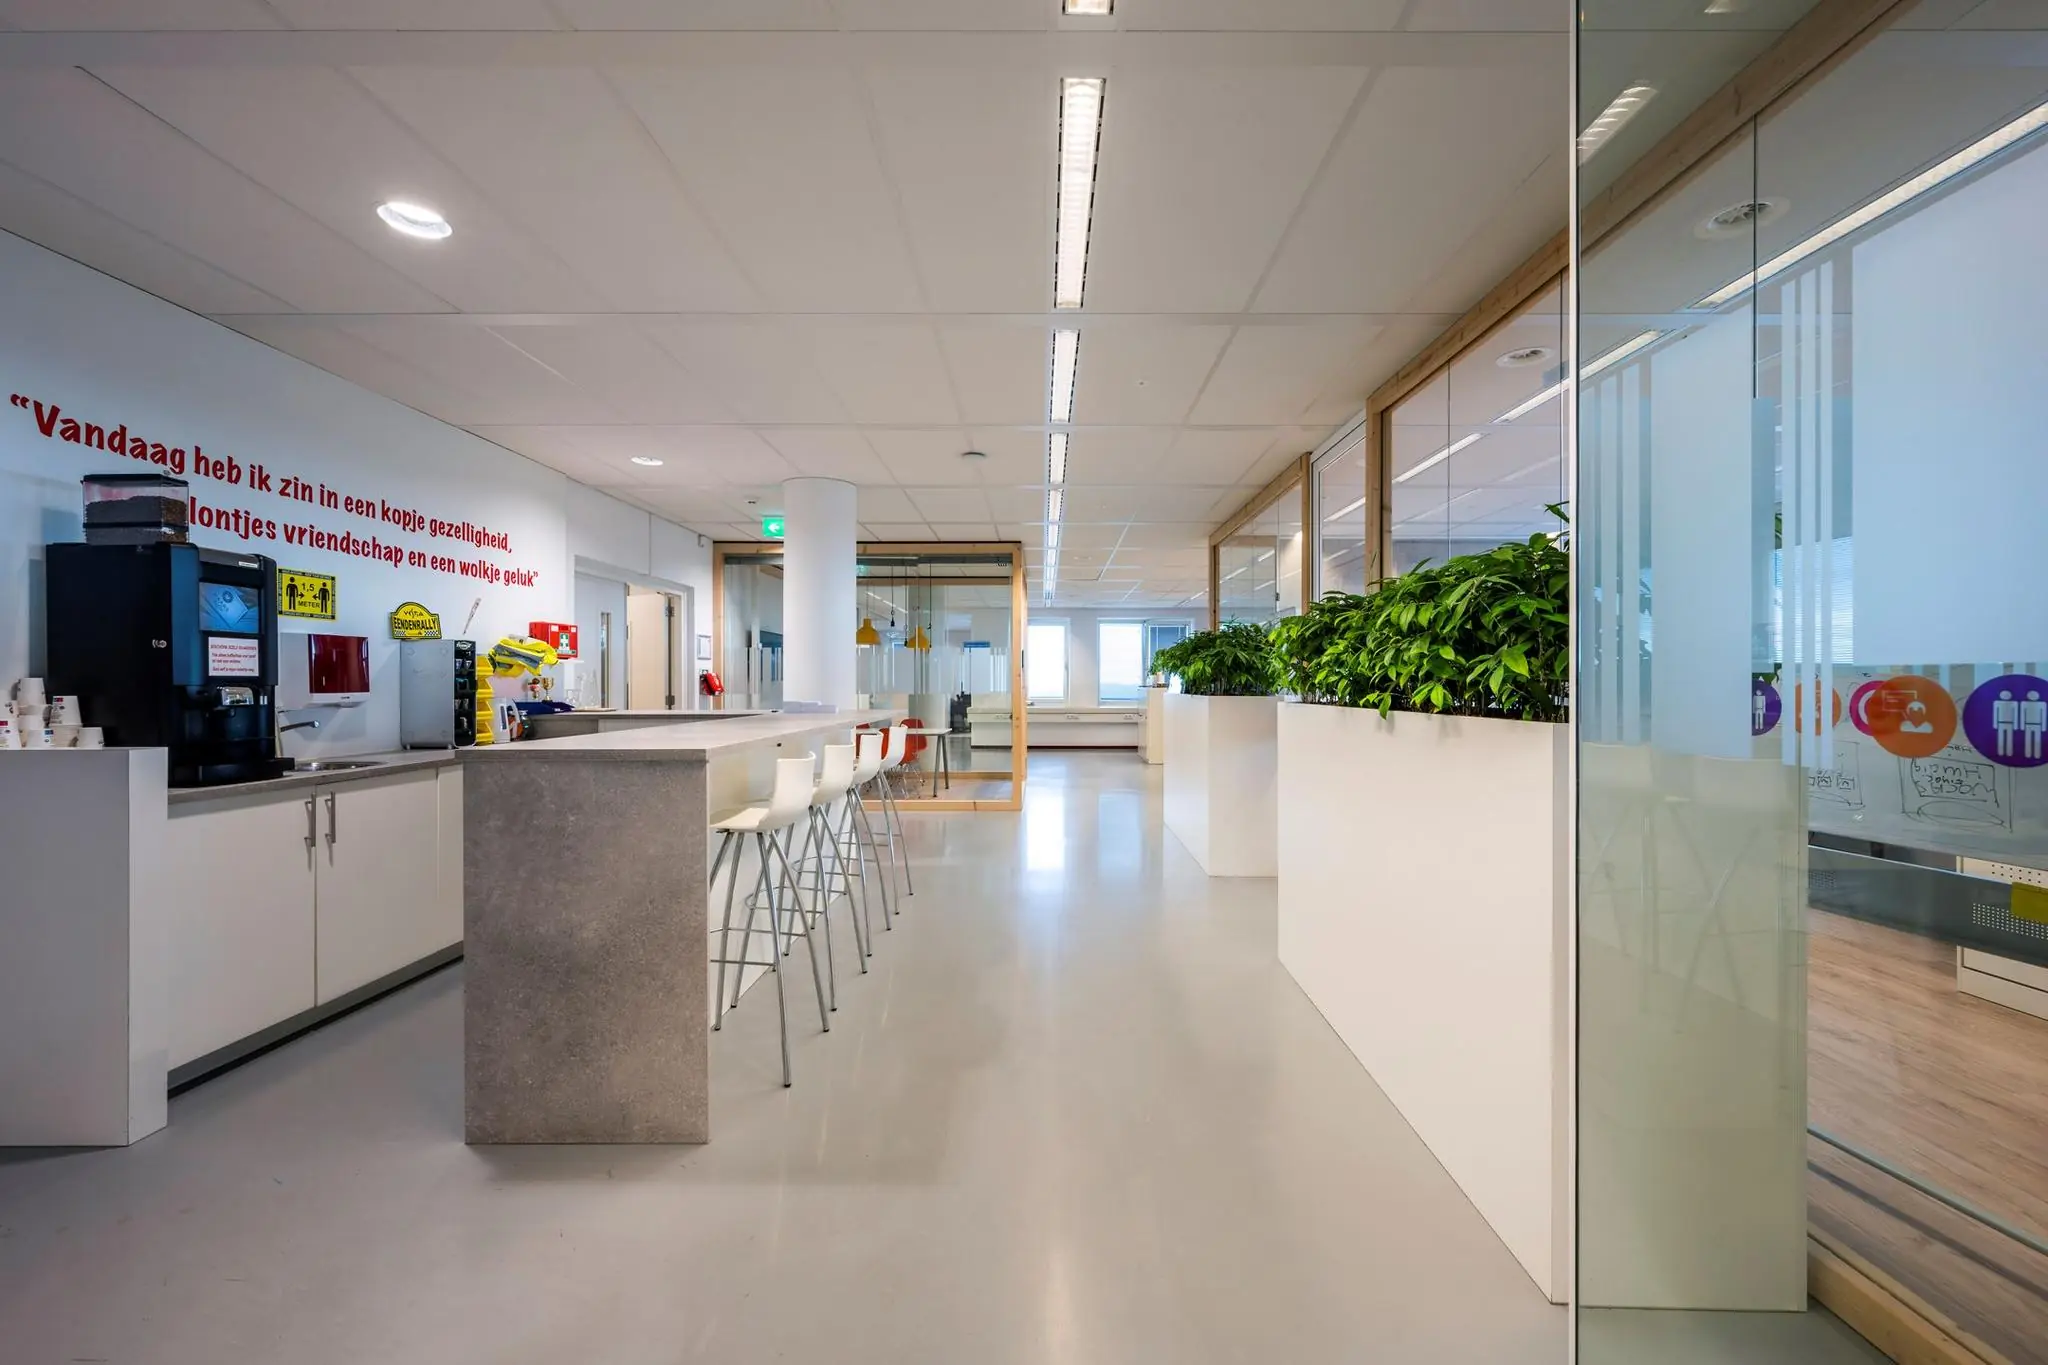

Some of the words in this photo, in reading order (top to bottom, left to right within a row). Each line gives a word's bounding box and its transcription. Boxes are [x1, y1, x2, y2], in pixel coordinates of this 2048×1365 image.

[194, 445, 241, 485] heb
[249, 463, 272, 492] ik
[278, 476, 313, 503] zin
[319, 484, 338, 510] in
[344, 495, 376, 519] een
[381, 499, 425, 532] kopje
[429, 518, 512, 553] gezelligheid,
[189, 496, 276, 540] lontjes
[283, 523, 403, 568] vriendschap
[408, 550, 427, 568] en
[431, 555, 455, 573] een
[459, 559, 500, 584] wolkje
[301, 582, 315, 592] 1,5
[298, 600, 321, 608] METER
[393, 616, 437, 631] EENDENRALLY
